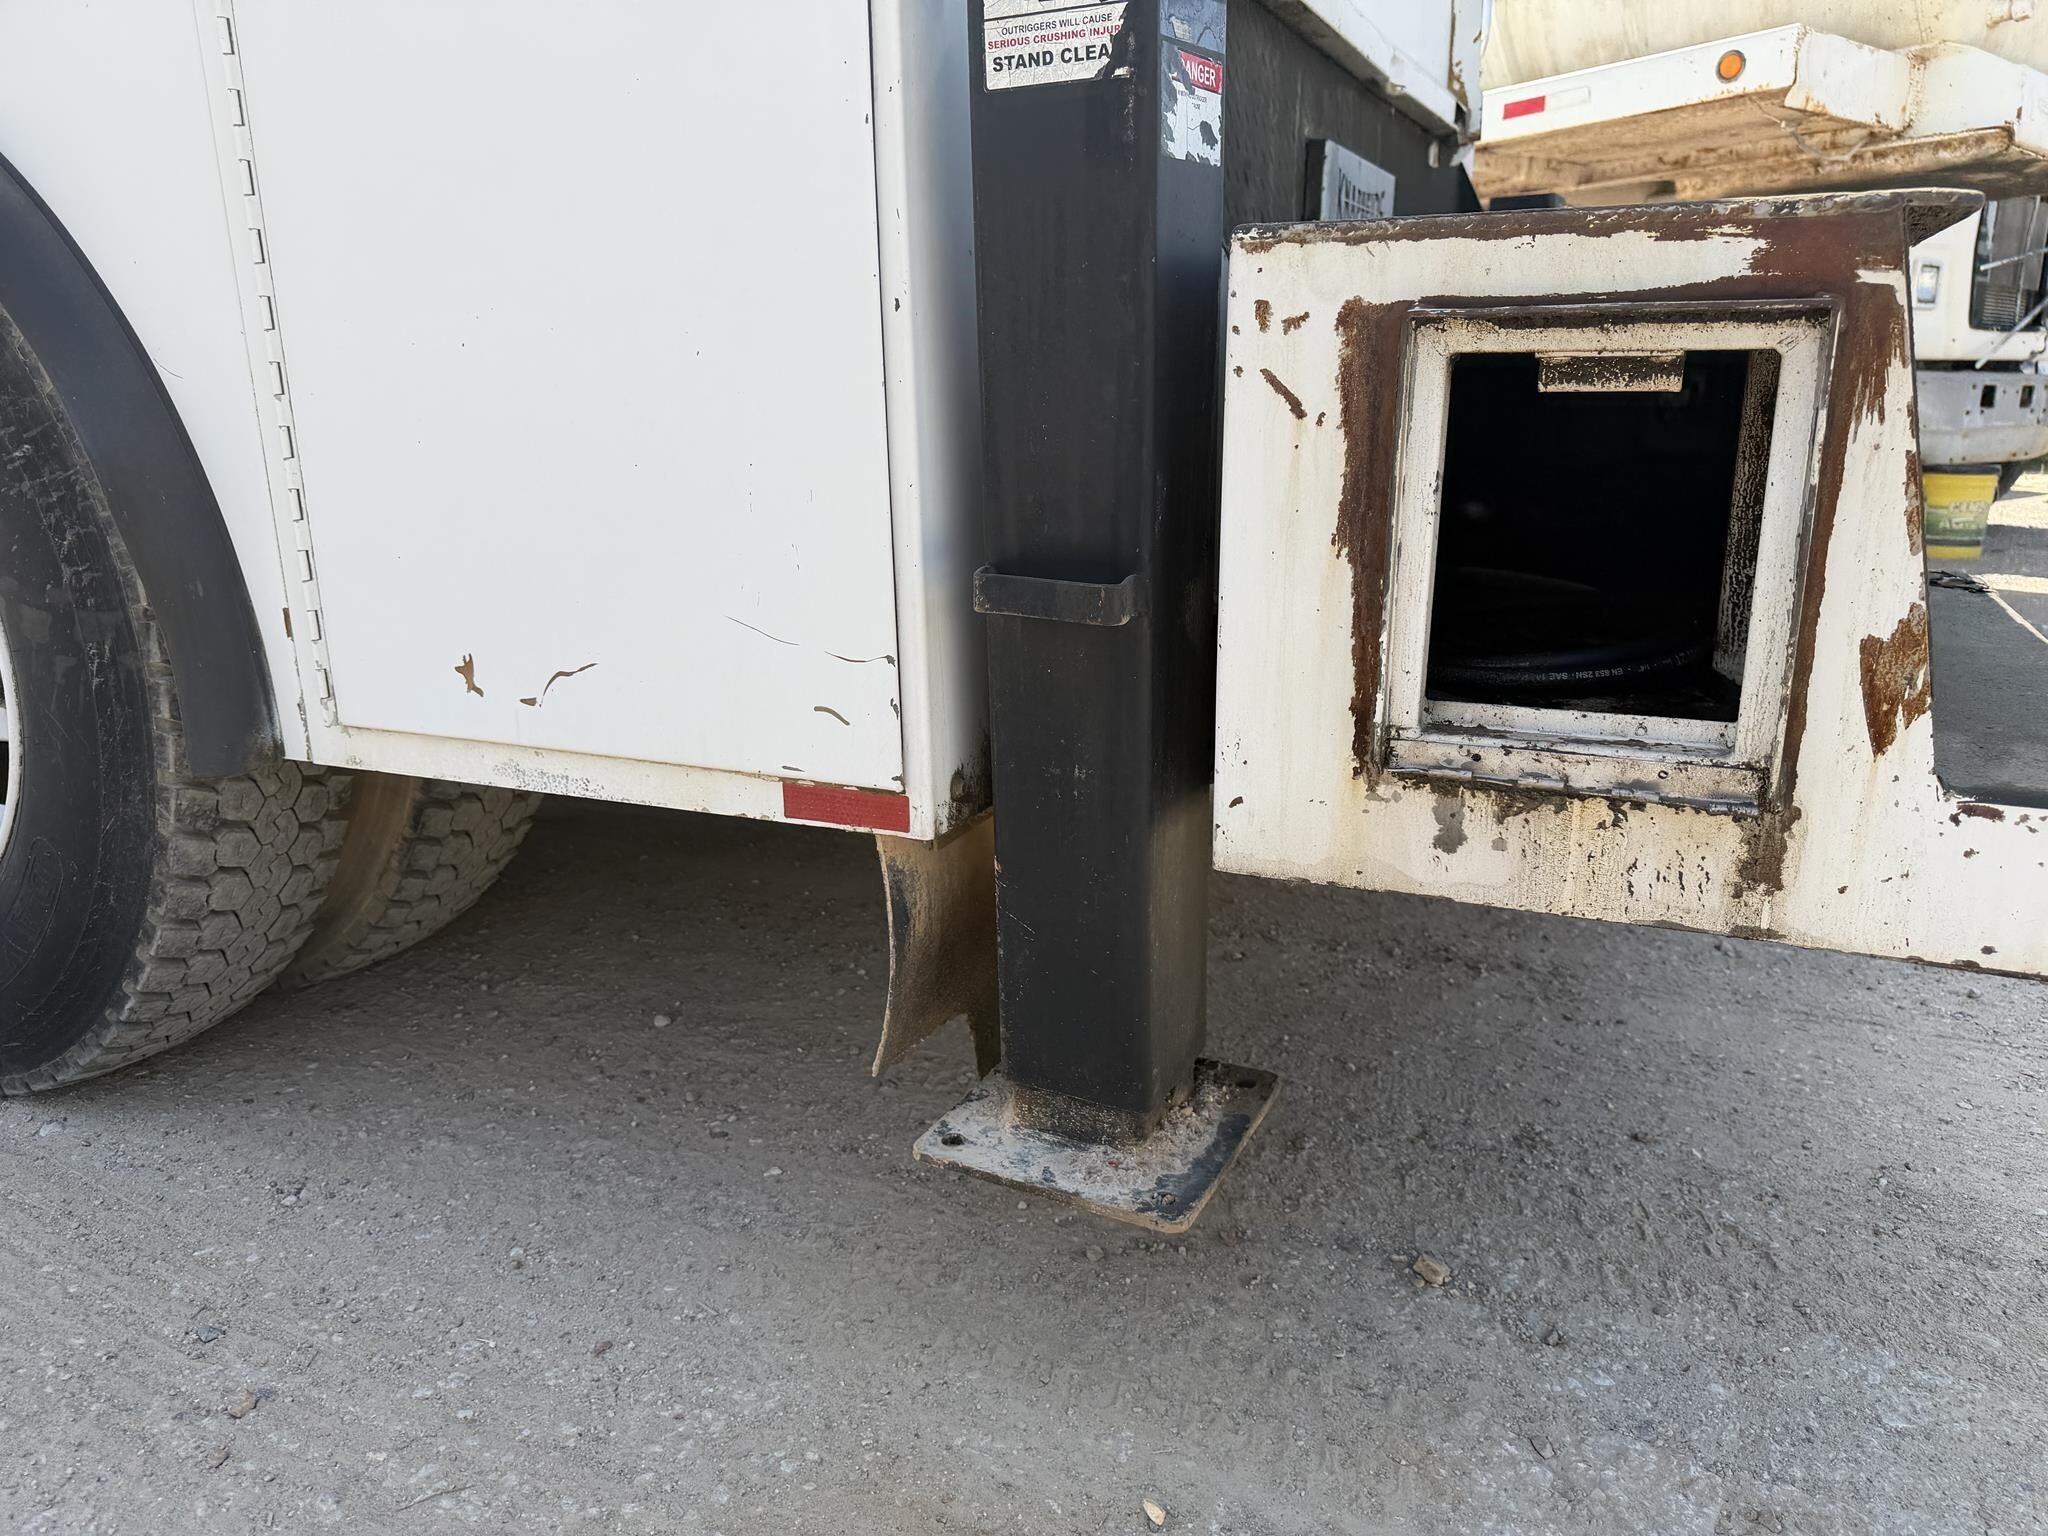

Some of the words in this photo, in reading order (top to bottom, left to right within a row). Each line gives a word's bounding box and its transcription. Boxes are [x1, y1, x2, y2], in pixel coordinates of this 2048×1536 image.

[988, 35, 1031, 50] SERIOUS
[1033, 28, 1086, 44] CRUSHING
[1089, 24, 1121, 37] INJUR
[1001, 20, 1057, 36] OUTRIGGERS
[1060, 18, 1080, 28] WILL
[1082, 13, 1113, 25] CAUSE
[992, 50, 1054, 73] STAND
[1060, 43, 1111, 64] CLEA
[1182, 59, 1216, 87] ANGER
[1549, 672, 1569, 680] SAE
